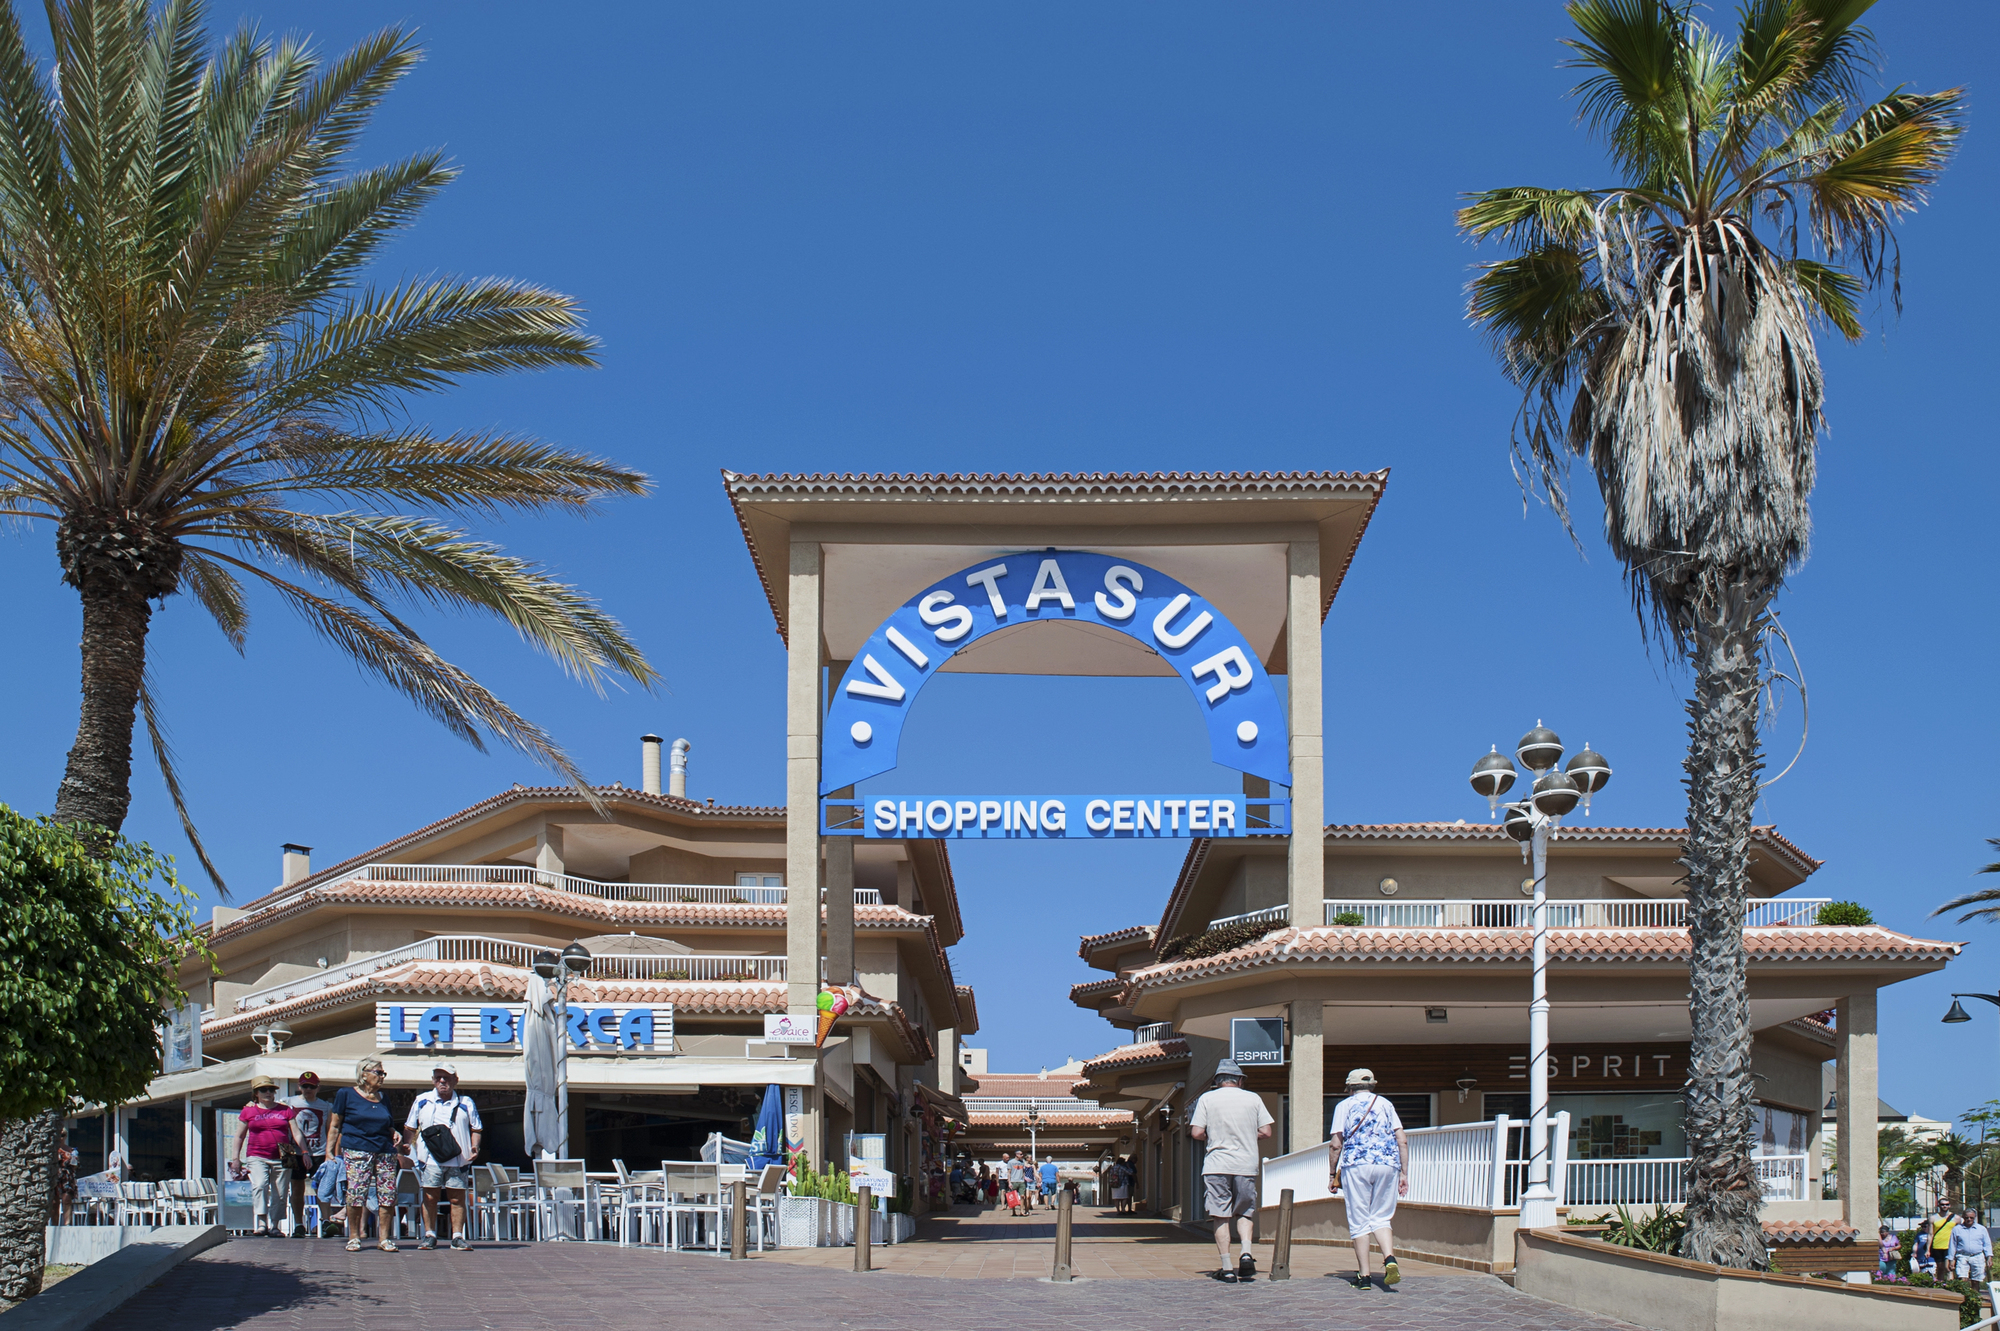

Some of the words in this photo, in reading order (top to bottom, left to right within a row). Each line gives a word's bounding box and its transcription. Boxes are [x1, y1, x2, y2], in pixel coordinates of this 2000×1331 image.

[874, 799, 1066, 831] SHOPPING
[1085, 799, 1236, 831] CENTER
[389, 1006, 454, 1047] LA
[1236, 1051, 1279, 1061] ESPRIT
[1509, 1055, 1671, 1078] ESPRIT
[789, 1088, 798, 1138] PESCADOS
